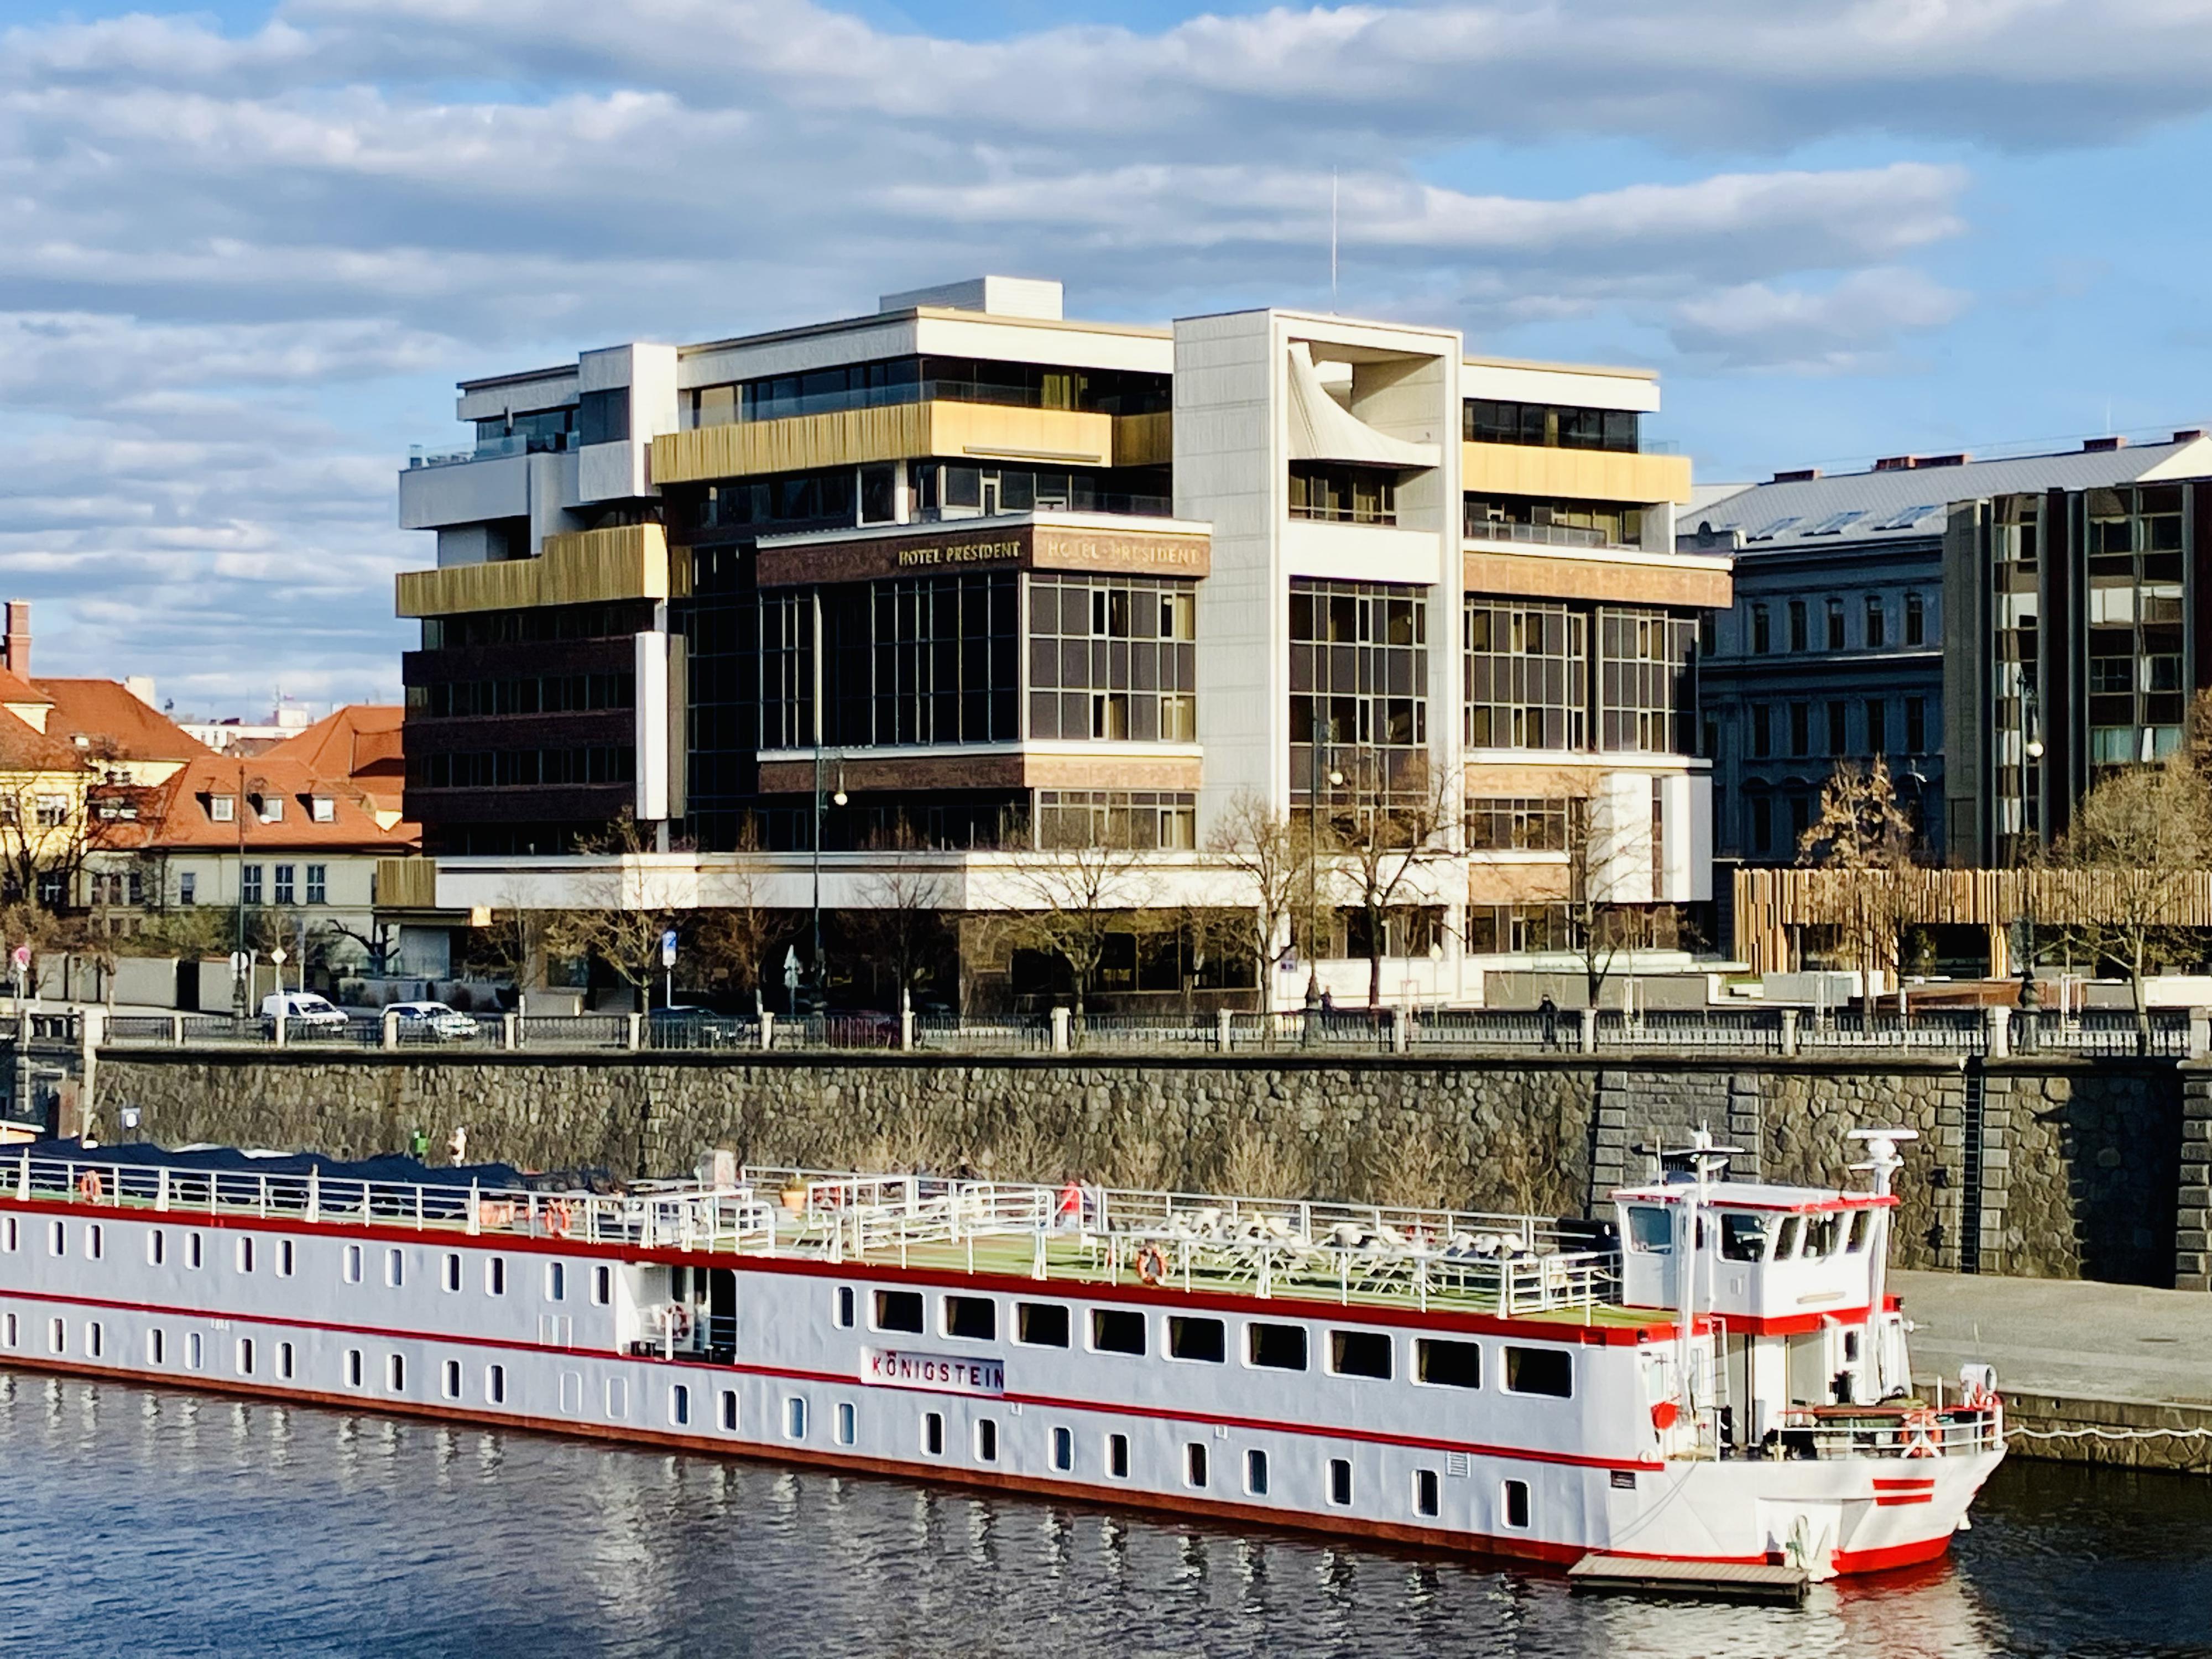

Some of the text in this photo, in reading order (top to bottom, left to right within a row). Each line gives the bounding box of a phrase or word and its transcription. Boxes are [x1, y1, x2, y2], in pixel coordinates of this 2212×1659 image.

[899, 540, 1021, 566] HOTEL PRESIDENT
[872, 1350, 1004, 1389] KÖNIGSTEIN
